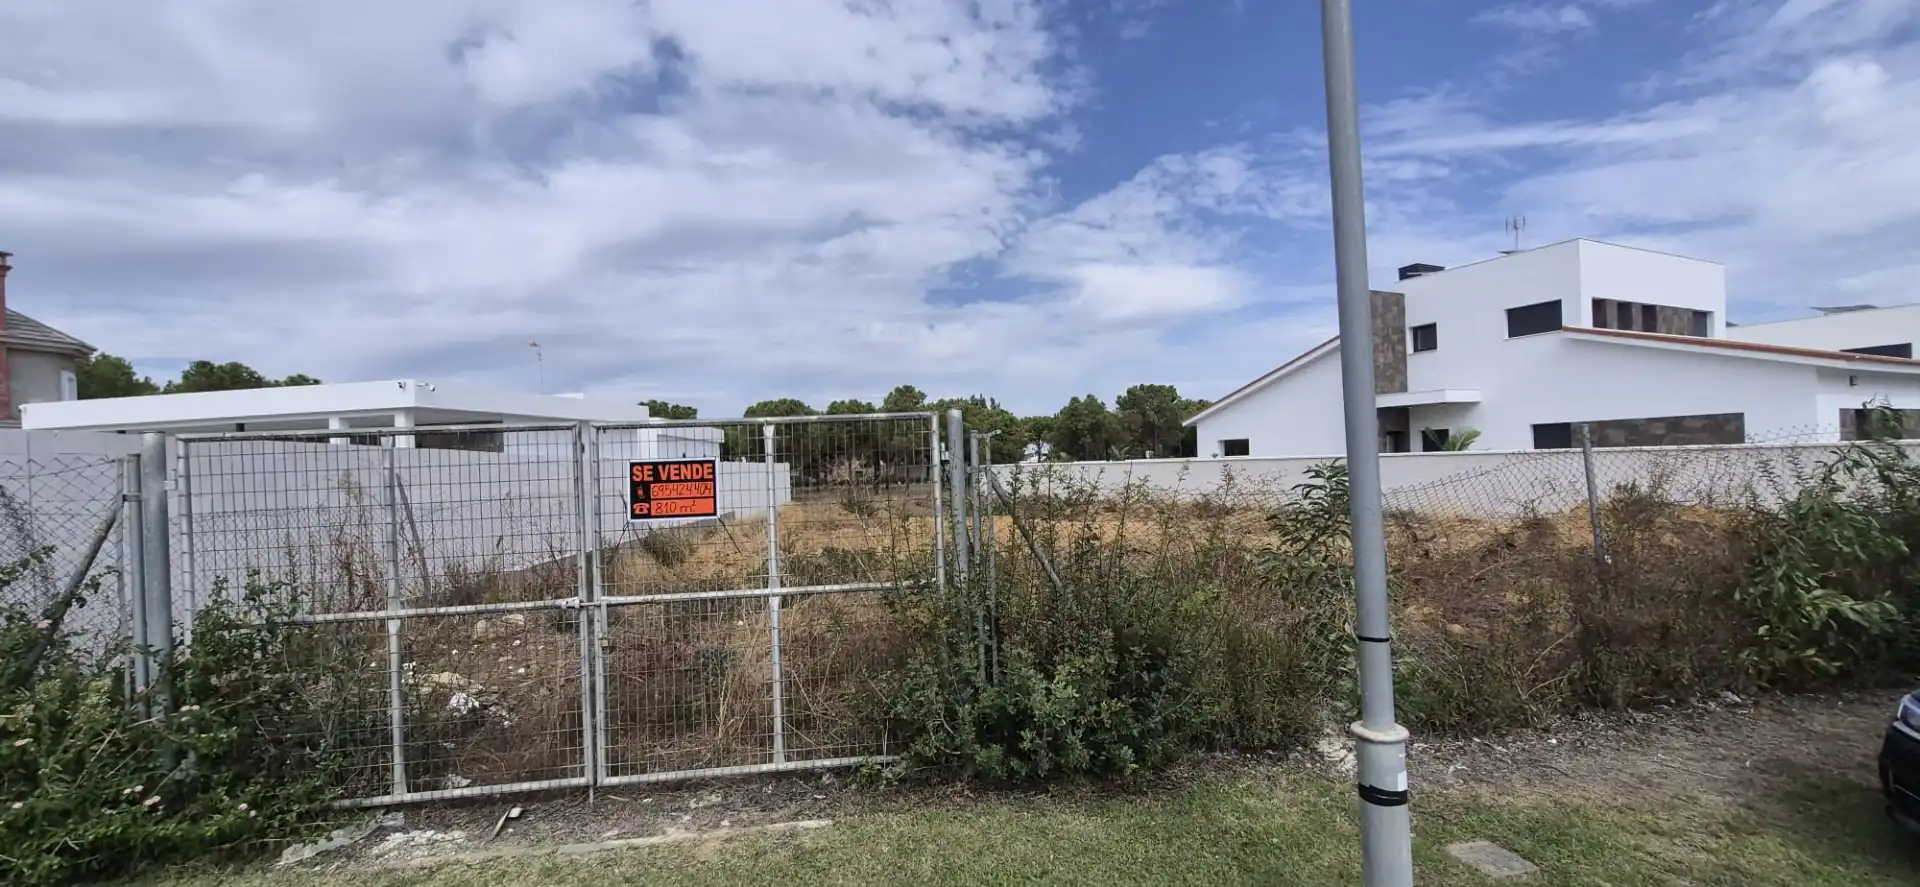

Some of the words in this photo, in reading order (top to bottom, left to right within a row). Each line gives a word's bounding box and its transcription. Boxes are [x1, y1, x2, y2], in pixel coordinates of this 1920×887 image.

[632, 465, 653, 482] SE
[658, 463, 713, 481] VENDE
[652, 482, 712, 497] 695424404
[655, 501, 677, 514] 810
